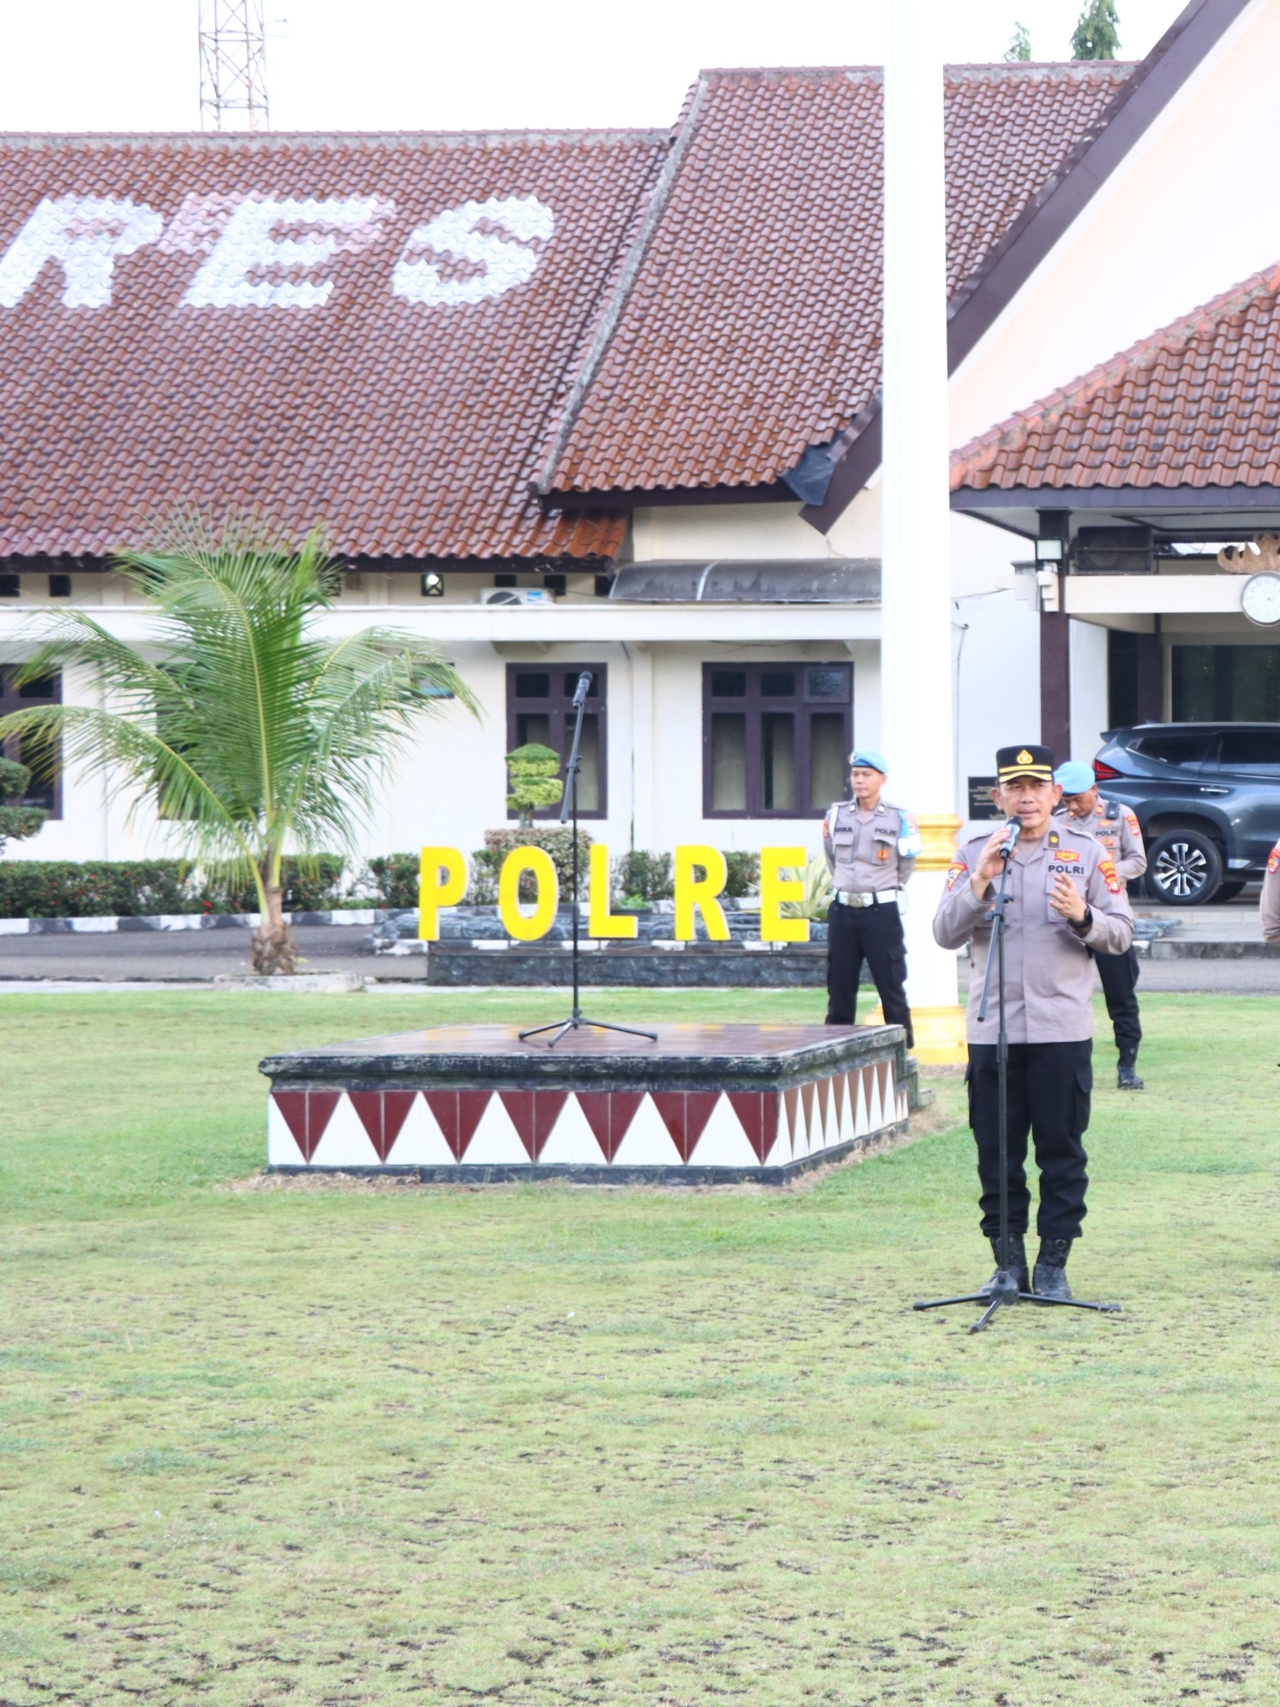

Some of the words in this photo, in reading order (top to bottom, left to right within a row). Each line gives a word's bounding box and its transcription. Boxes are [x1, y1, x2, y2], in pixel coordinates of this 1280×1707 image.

[0, 196, 555, 310] RES
[418, 844, 810, 942] POLRE
[1048, 864, 1085, 875] POLRI
